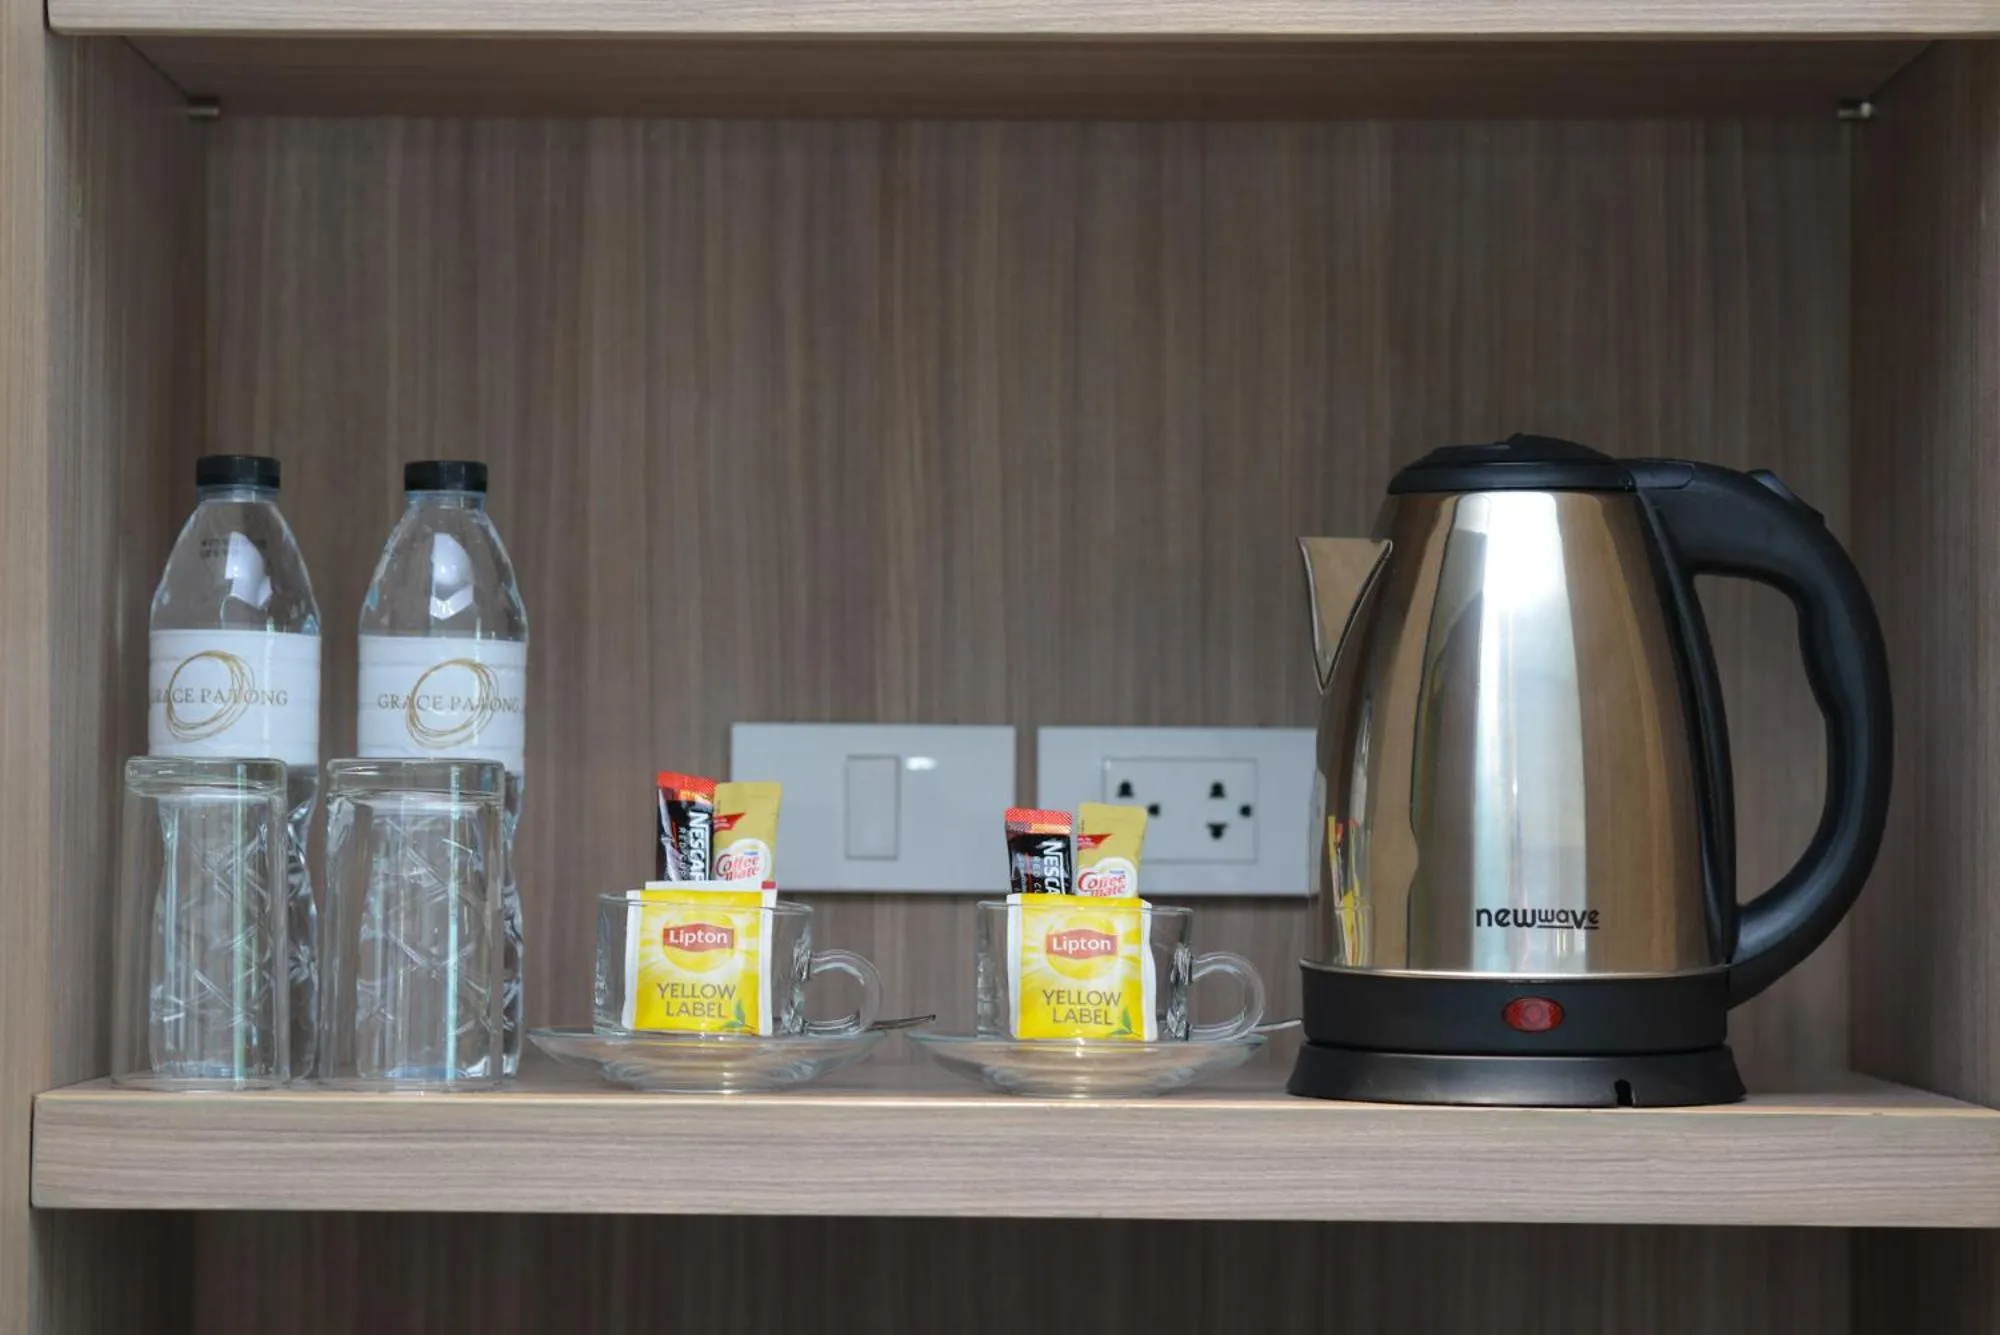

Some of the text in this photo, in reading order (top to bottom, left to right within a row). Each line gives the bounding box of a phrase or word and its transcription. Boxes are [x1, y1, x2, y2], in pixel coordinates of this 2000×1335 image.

[377, 692, 445, 711] GRACE
[1476, 908, 1600, 929] newwave
[669, 929, 729, 947] Lipton
[1052, 937, 1111, 954] Lipton
[656, 982, 736, 1001] YELLOW
[1042, 989, 1122, 1007] YELLOW
[665, 1002, 727, 1019] LABEL
[1052, 1007, 1115, 1026] LABEL
